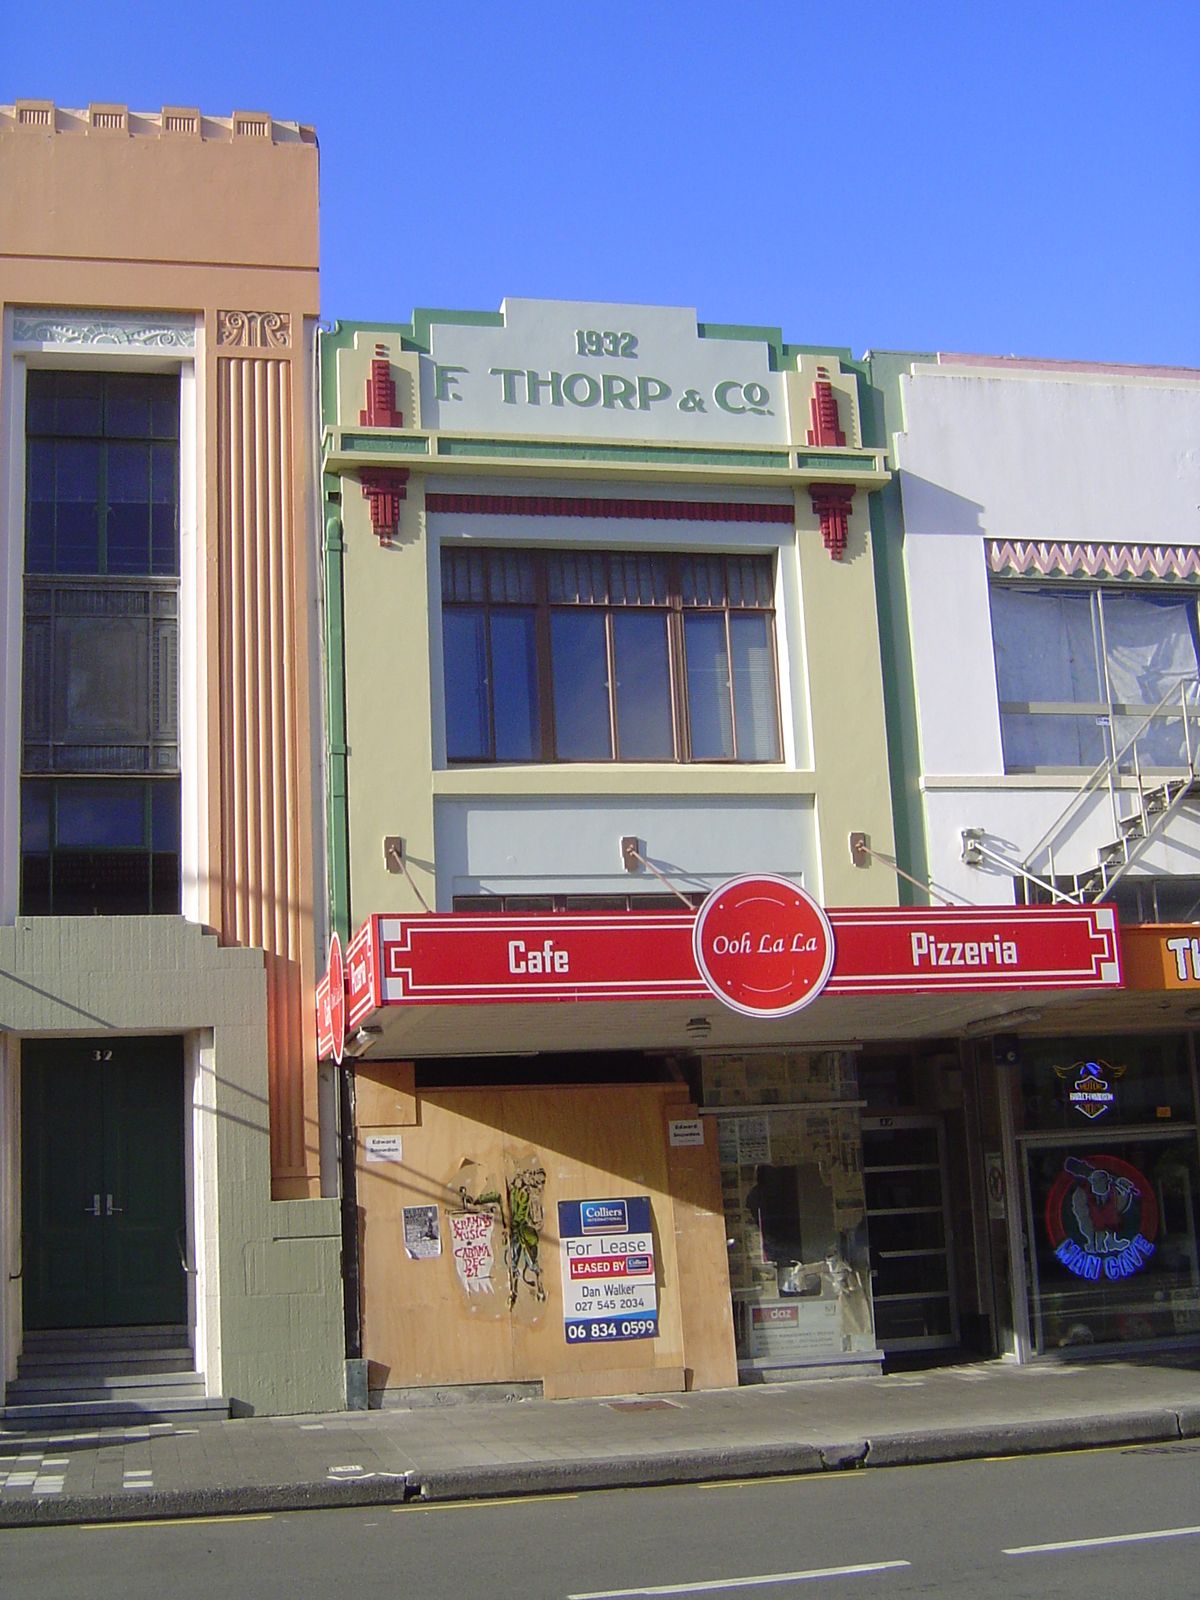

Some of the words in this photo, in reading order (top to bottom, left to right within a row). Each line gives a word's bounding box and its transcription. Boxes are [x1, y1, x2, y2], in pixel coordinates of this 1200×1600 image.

[575, 329, 639, 359] 1932
[488, 367, 672, 411] THORP
[677, 389, 708, 413] &
[713, 932, 752, 954] Ooh
[757, 934, 785, 953] La
[790, 933, 818, 952] La
[911, 932, 1018, 967] Pizzeria
[508, 940, 569, 974] Cafe
[91, 1049, 113, 1061] 32
[586, 1207, 622, 1218] Colliers
[453, 1229, 487, 1241] MUSIC
[566, 1240, 592, 1256] For
[600, 1239, 646, 1254] Lease
[464, 1257, 486, 1268] DEC
[1056, 1238, 1102, 1280] MAN
[1105, 1233, 1155, 1280] CAVE
[572, 1262, 610, 1274] LEASED
[613, 1261, 625, 1272] BY
[582, 1286, 600, 1298] Dan
[604, 1285, 636, 1296] Walker
[575, 1301, 592, 1311] 027
[597, 1300, 616, 1310] 545
[620, 1298, 644, 1309] 2034
[568, 1325, 586, 1339] 06
[591, 1323, 617, 1337] 834
[621, 1320, 655, 1335] 0599
